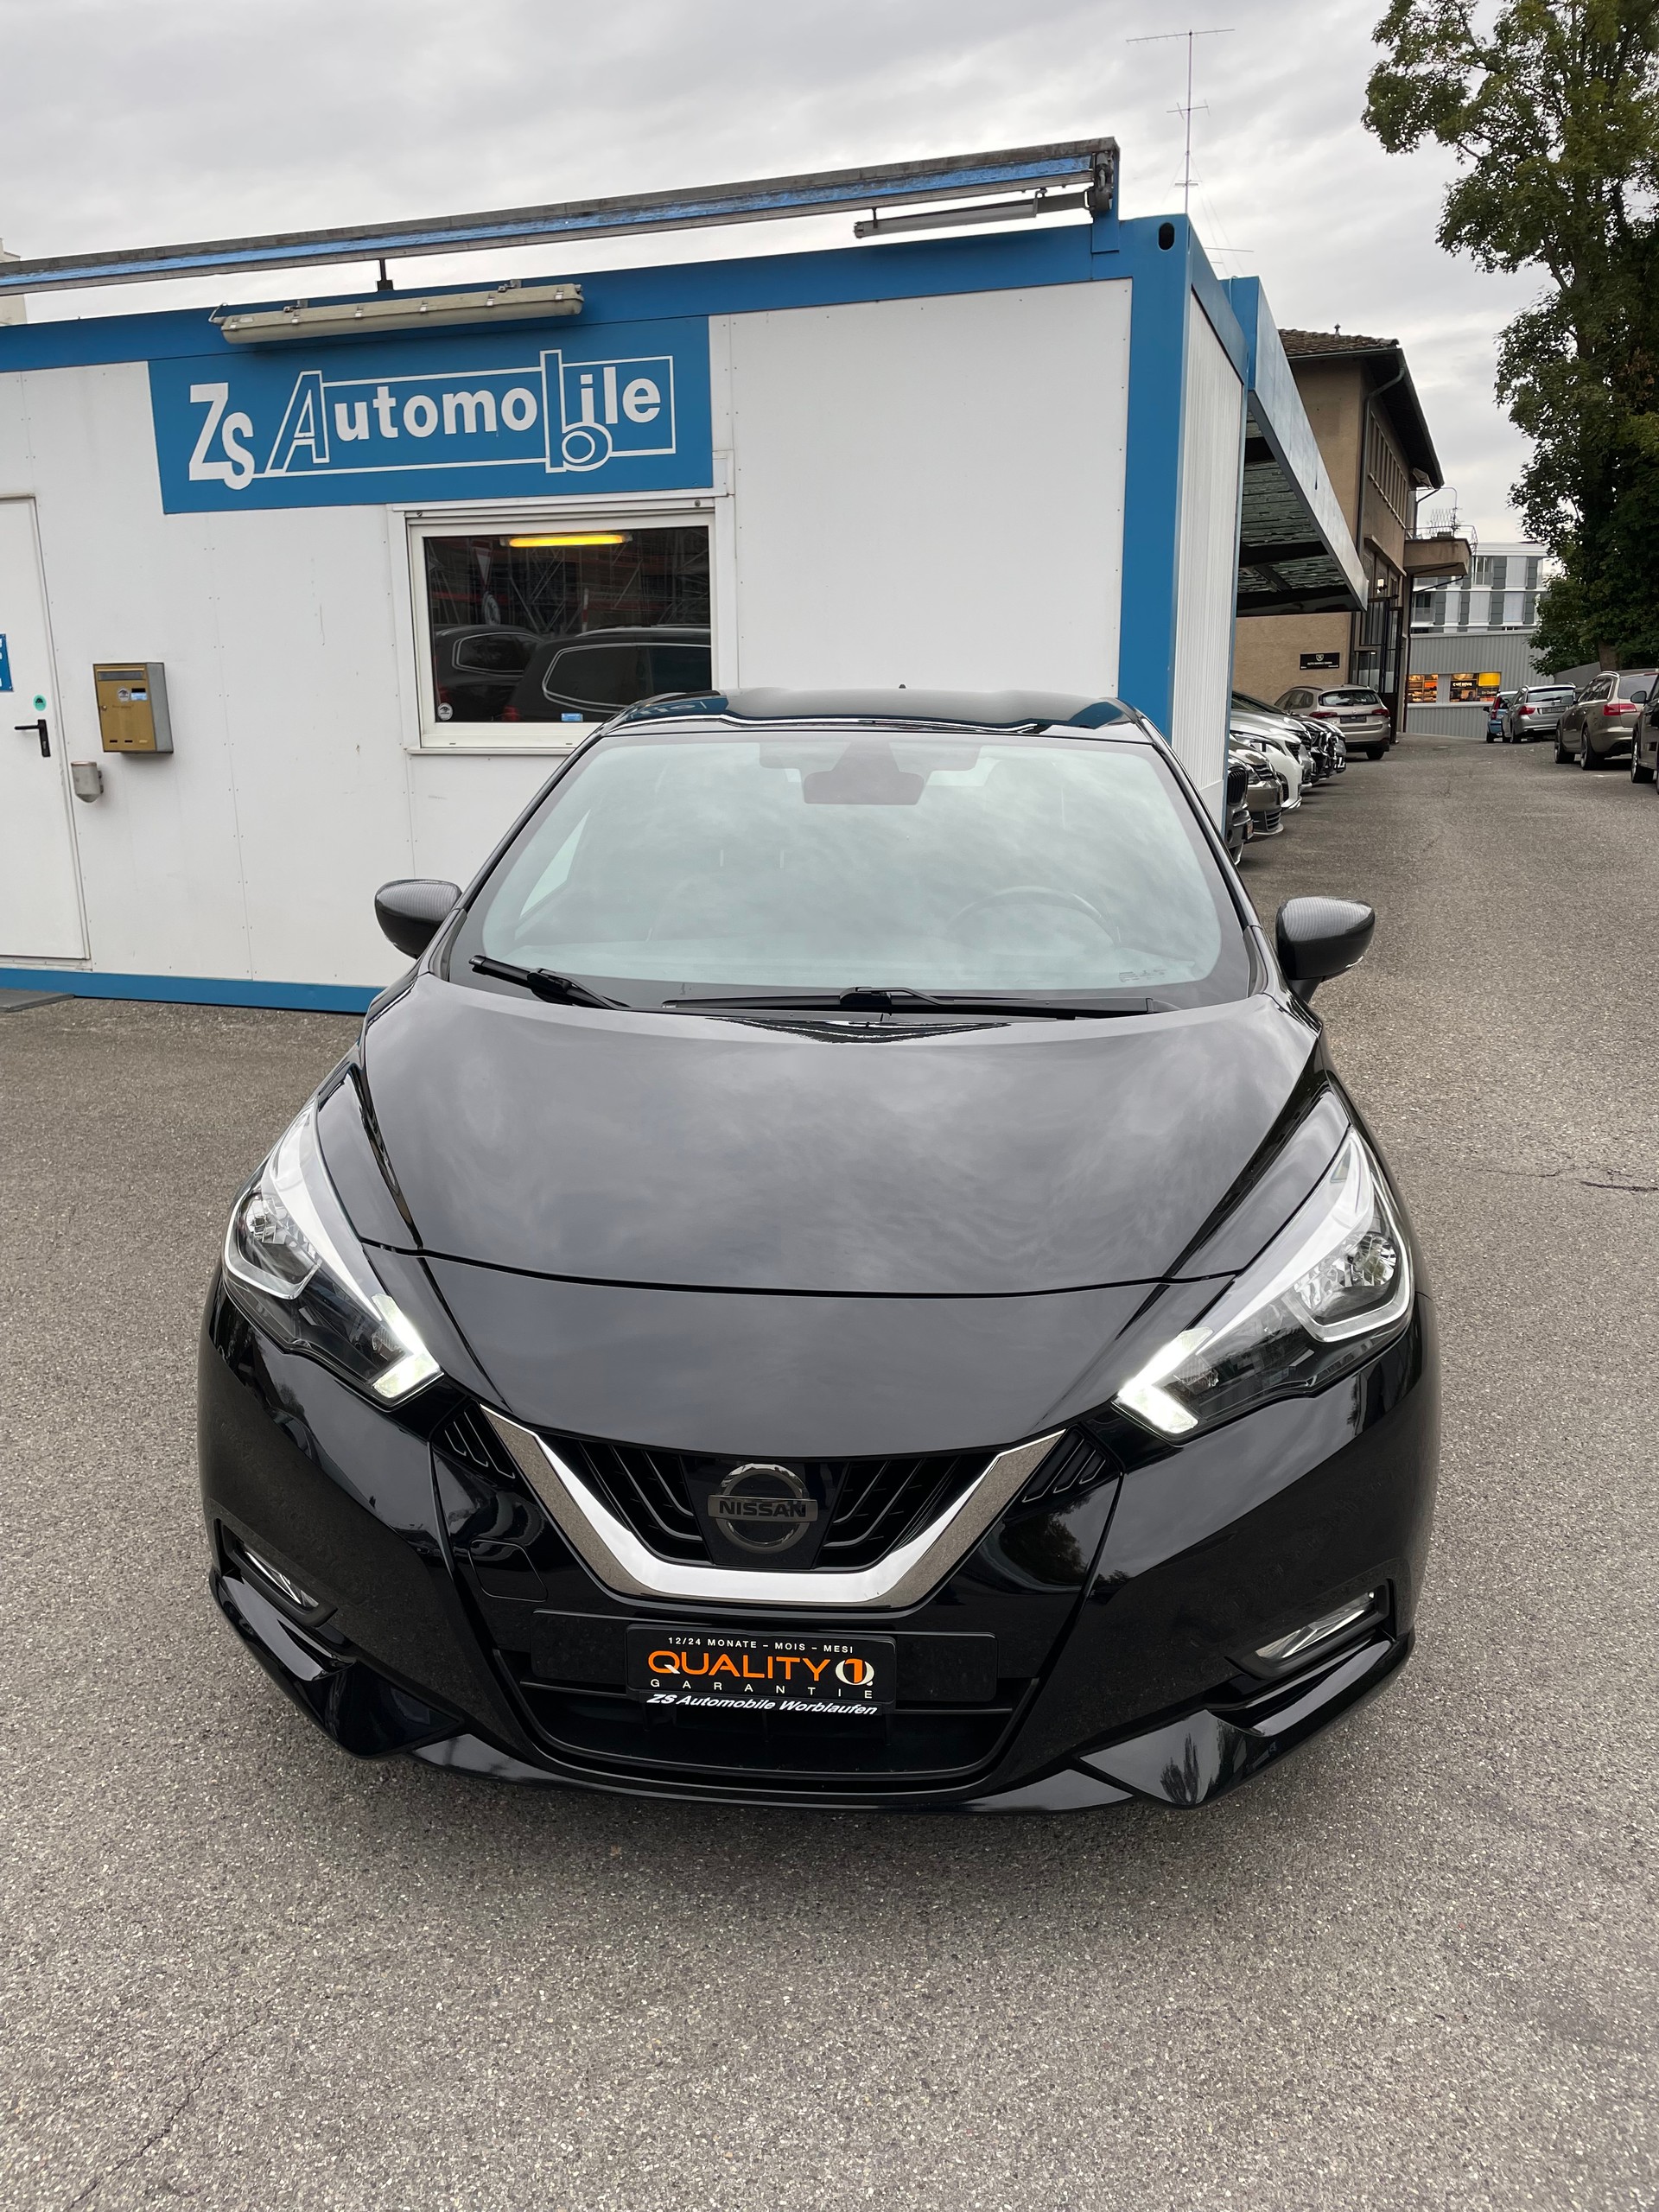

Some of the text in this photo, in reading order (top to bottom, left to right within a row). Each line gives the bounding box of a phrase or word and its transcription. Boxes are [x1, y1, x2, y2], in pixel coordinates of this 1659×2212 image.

[264, 348, 662, 474] Automobile
[719, 1499, 807, 1518] NISSAN
[668, 1637, 702, 1646] 12/24
[707, 1638, 758, 1649] MONATE
[774, 1642, 806, 1651] MOIS
[823, 1644, 854, 1654] MESI
[647, 1649, 831, 1682] QUALITY
[650, 1678, 873, 1699] GARANTIE
[646, 1694, 879, 1715] ZS Automobile Worblaufen
